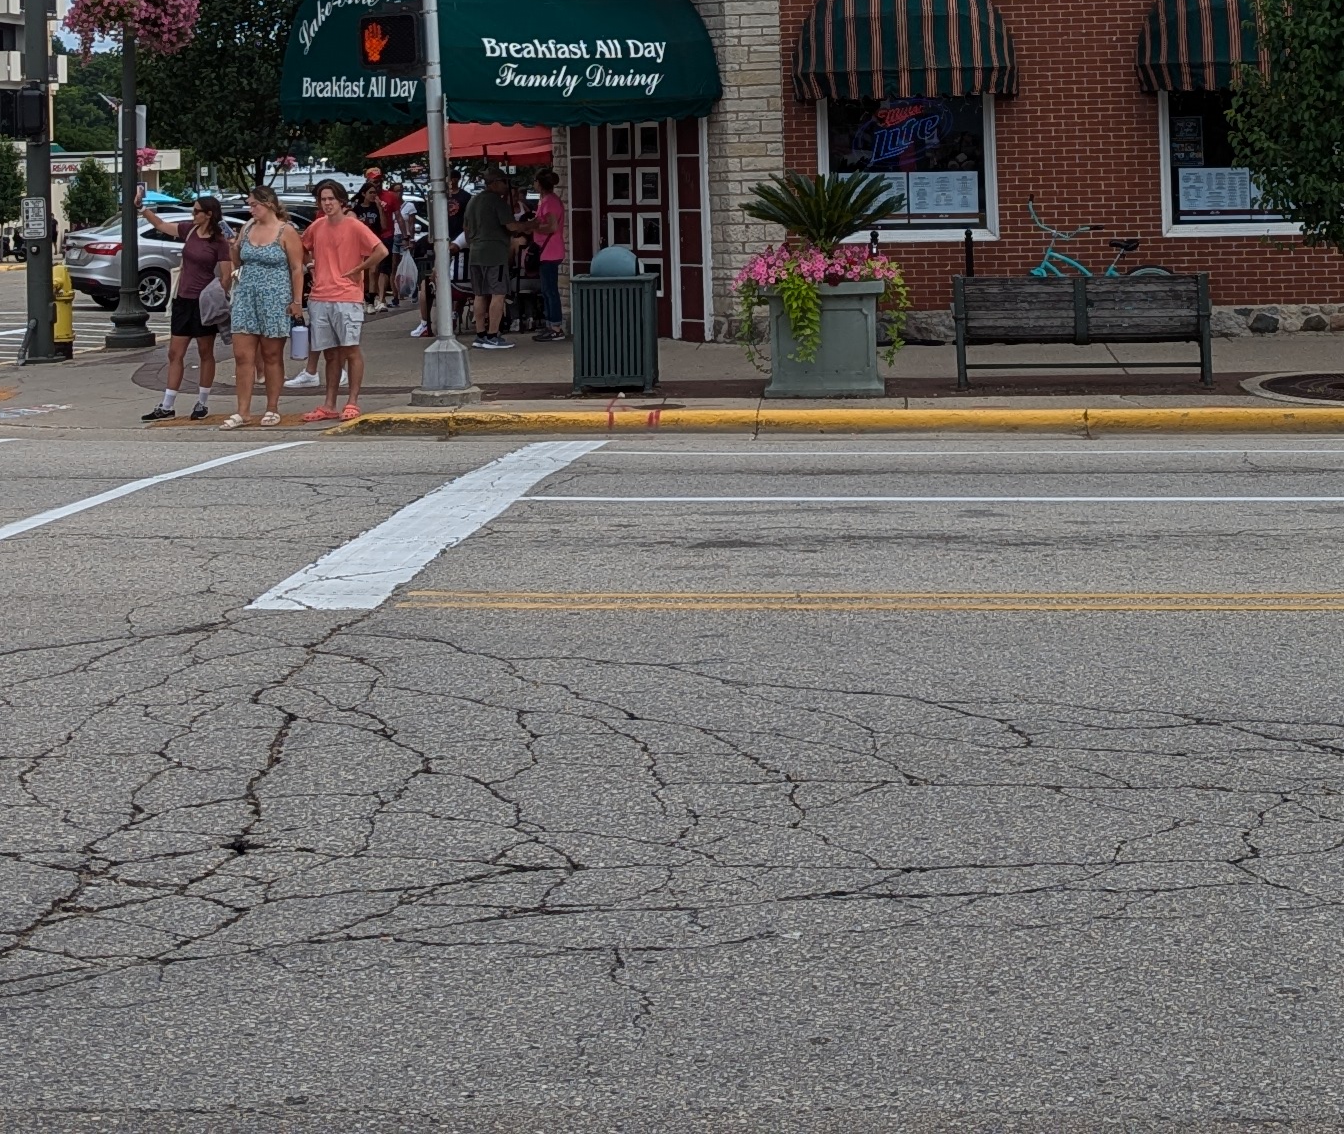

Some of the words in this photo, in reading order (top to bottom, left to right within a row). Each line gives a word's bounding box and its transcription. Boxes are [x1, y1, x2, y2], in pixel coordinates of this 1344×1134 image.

[481, 37, 590, 59] Breakfast
[594, 38, 622, 59] All
[626, 40, 667, 64] Day
[301, 76, 365, 98] Breakfast
[367, 76, 387, 98] All
[390, 77, 418, 102] Day
[495, 63, 584, 97] Family
[585, 66, 665, 96] Dining
